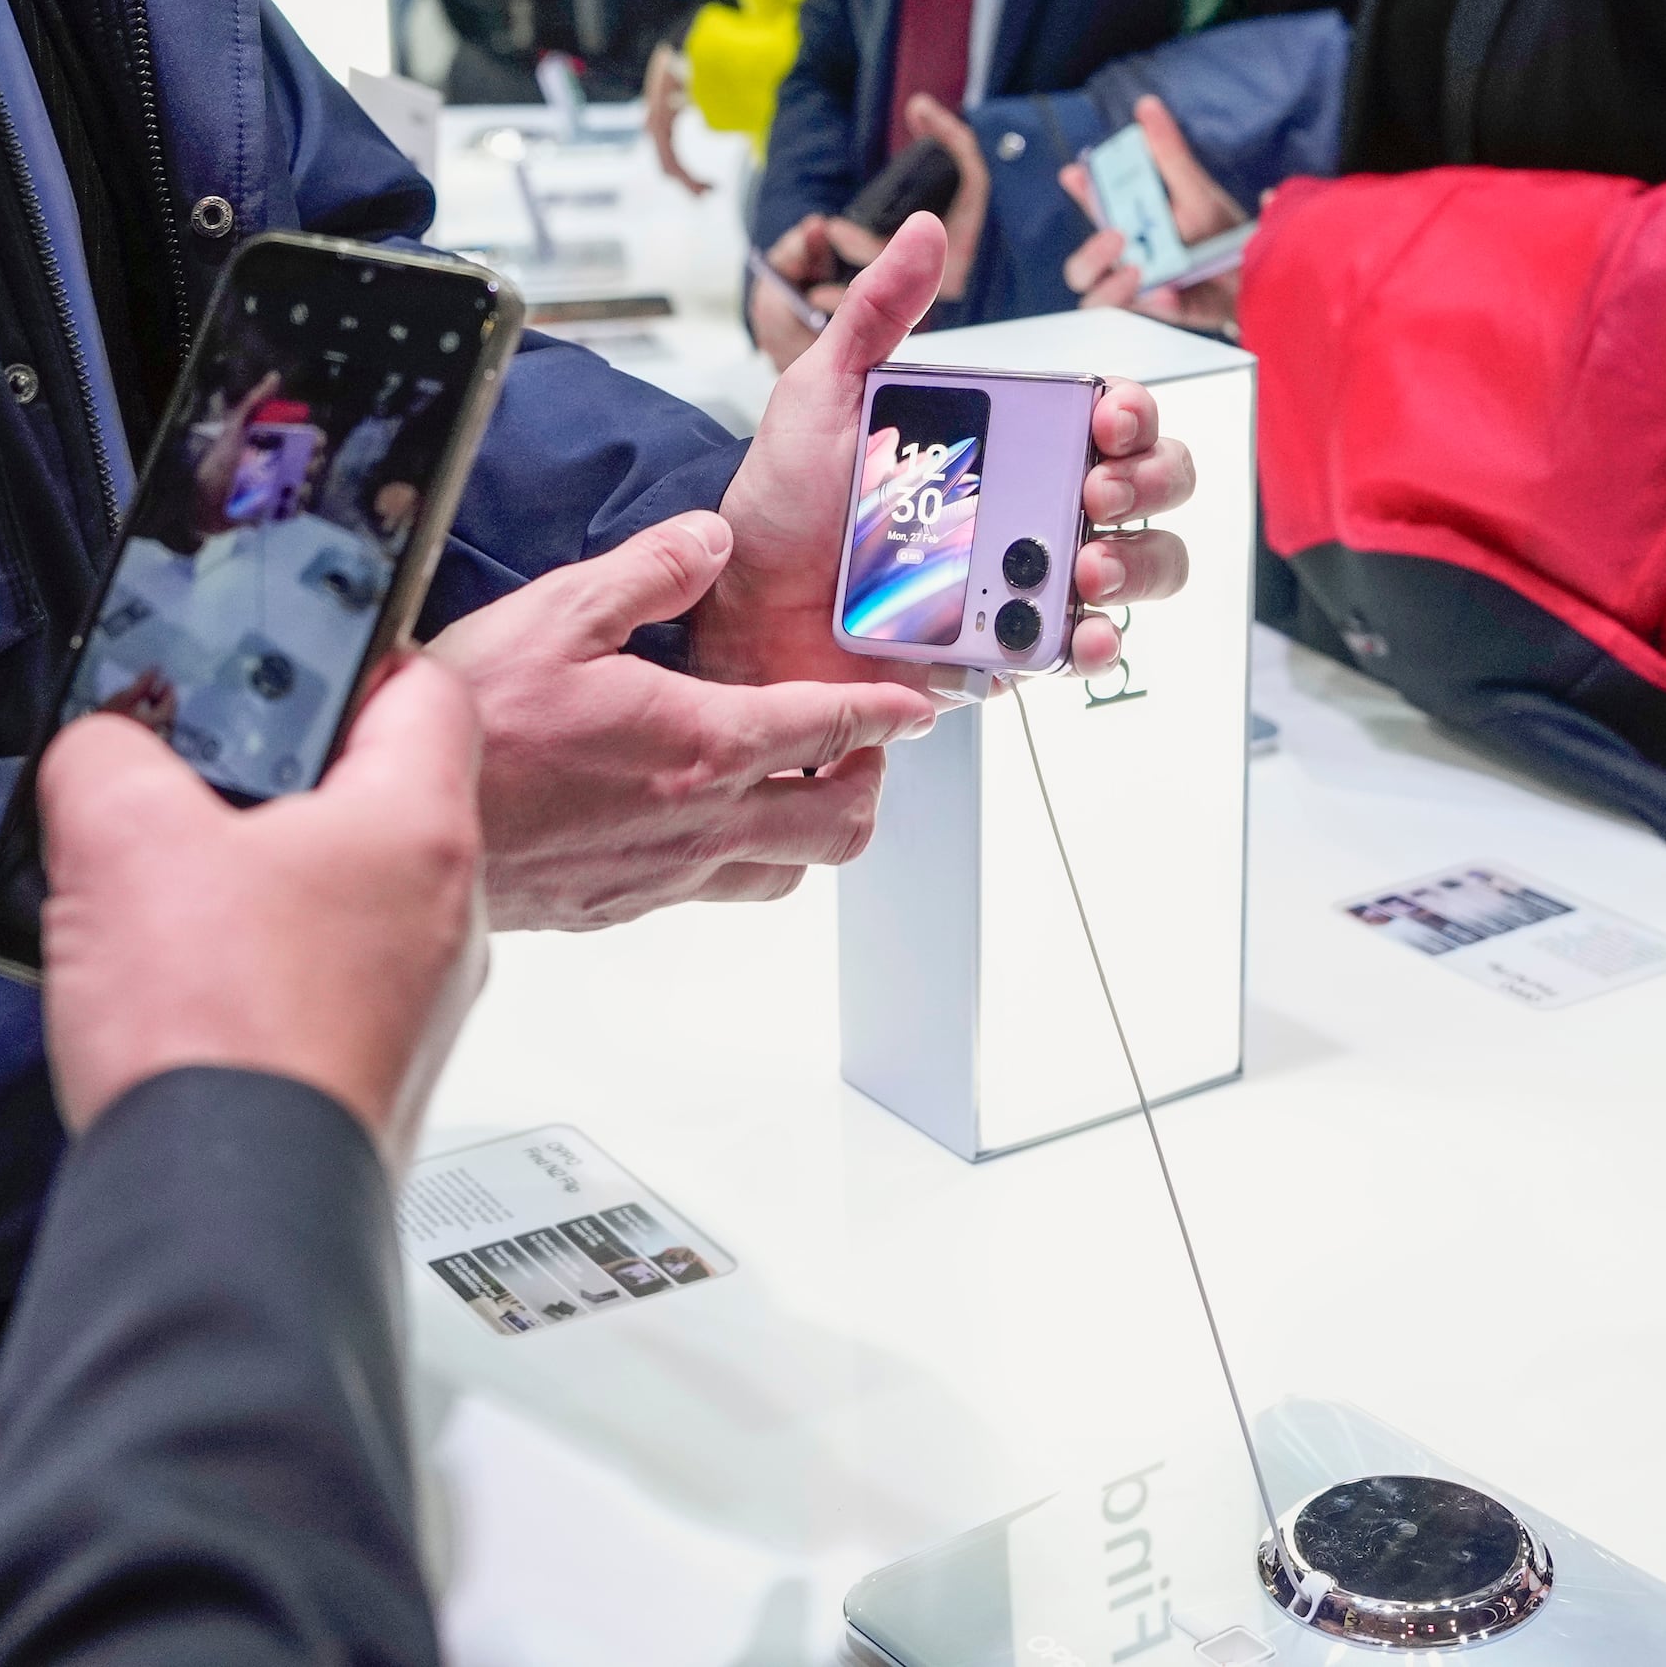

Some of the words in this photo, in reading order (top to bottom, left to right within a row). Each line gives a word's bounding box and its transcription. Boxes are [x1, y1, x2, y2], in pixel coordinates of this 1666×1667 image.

[900, 441, 949, 482] 12
[891, 485, 944, 525] 30
[887, 530, 909, 543] Mon,
[909, 533, 922, 543] 27
[922, 533, 939, 544] Feb
[522, 1146, 551, 1166] Find
[557, 1176, 582, 1194] Flip
